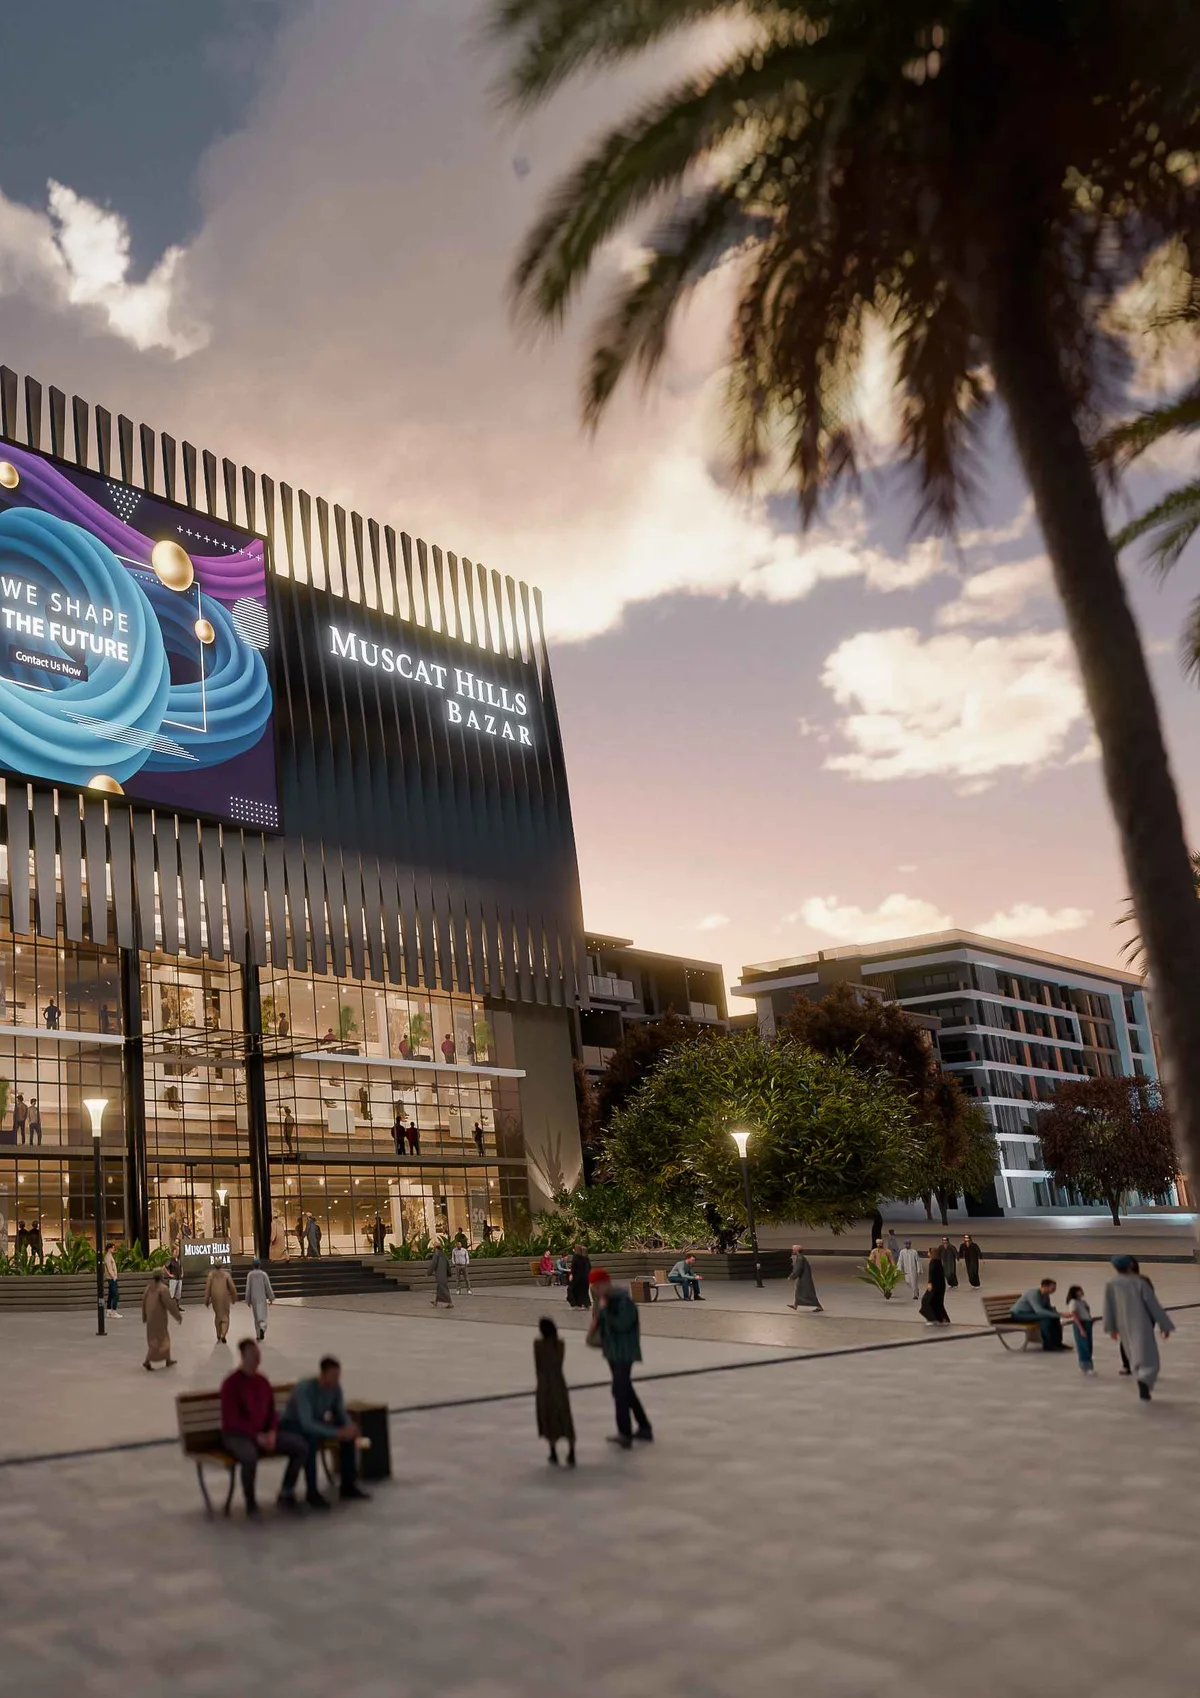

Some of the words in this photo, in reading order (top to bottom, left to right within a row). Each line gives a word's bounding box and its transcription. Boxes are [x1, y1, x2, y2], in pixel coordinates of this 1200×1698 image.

[1, 576, 38, 606] WE
[50, 592, 128, 632] SHAPE
[2, 607, 44, 638] THE
[49, 621, 128, 662] FUTURE
[15, 650, 49, 668] Contact
[50, 660, 61, 671] Us
[62, 663, 81, 676] Now
[329, 625, 447, 690] MUSCAT
[454, 667, 528, 716] HILLS
[446, 699, 533, 747] BAZAR
[184, 1244, 211, 1255] MUSCAT
[212, 1243, 230, 1254] HILLS
